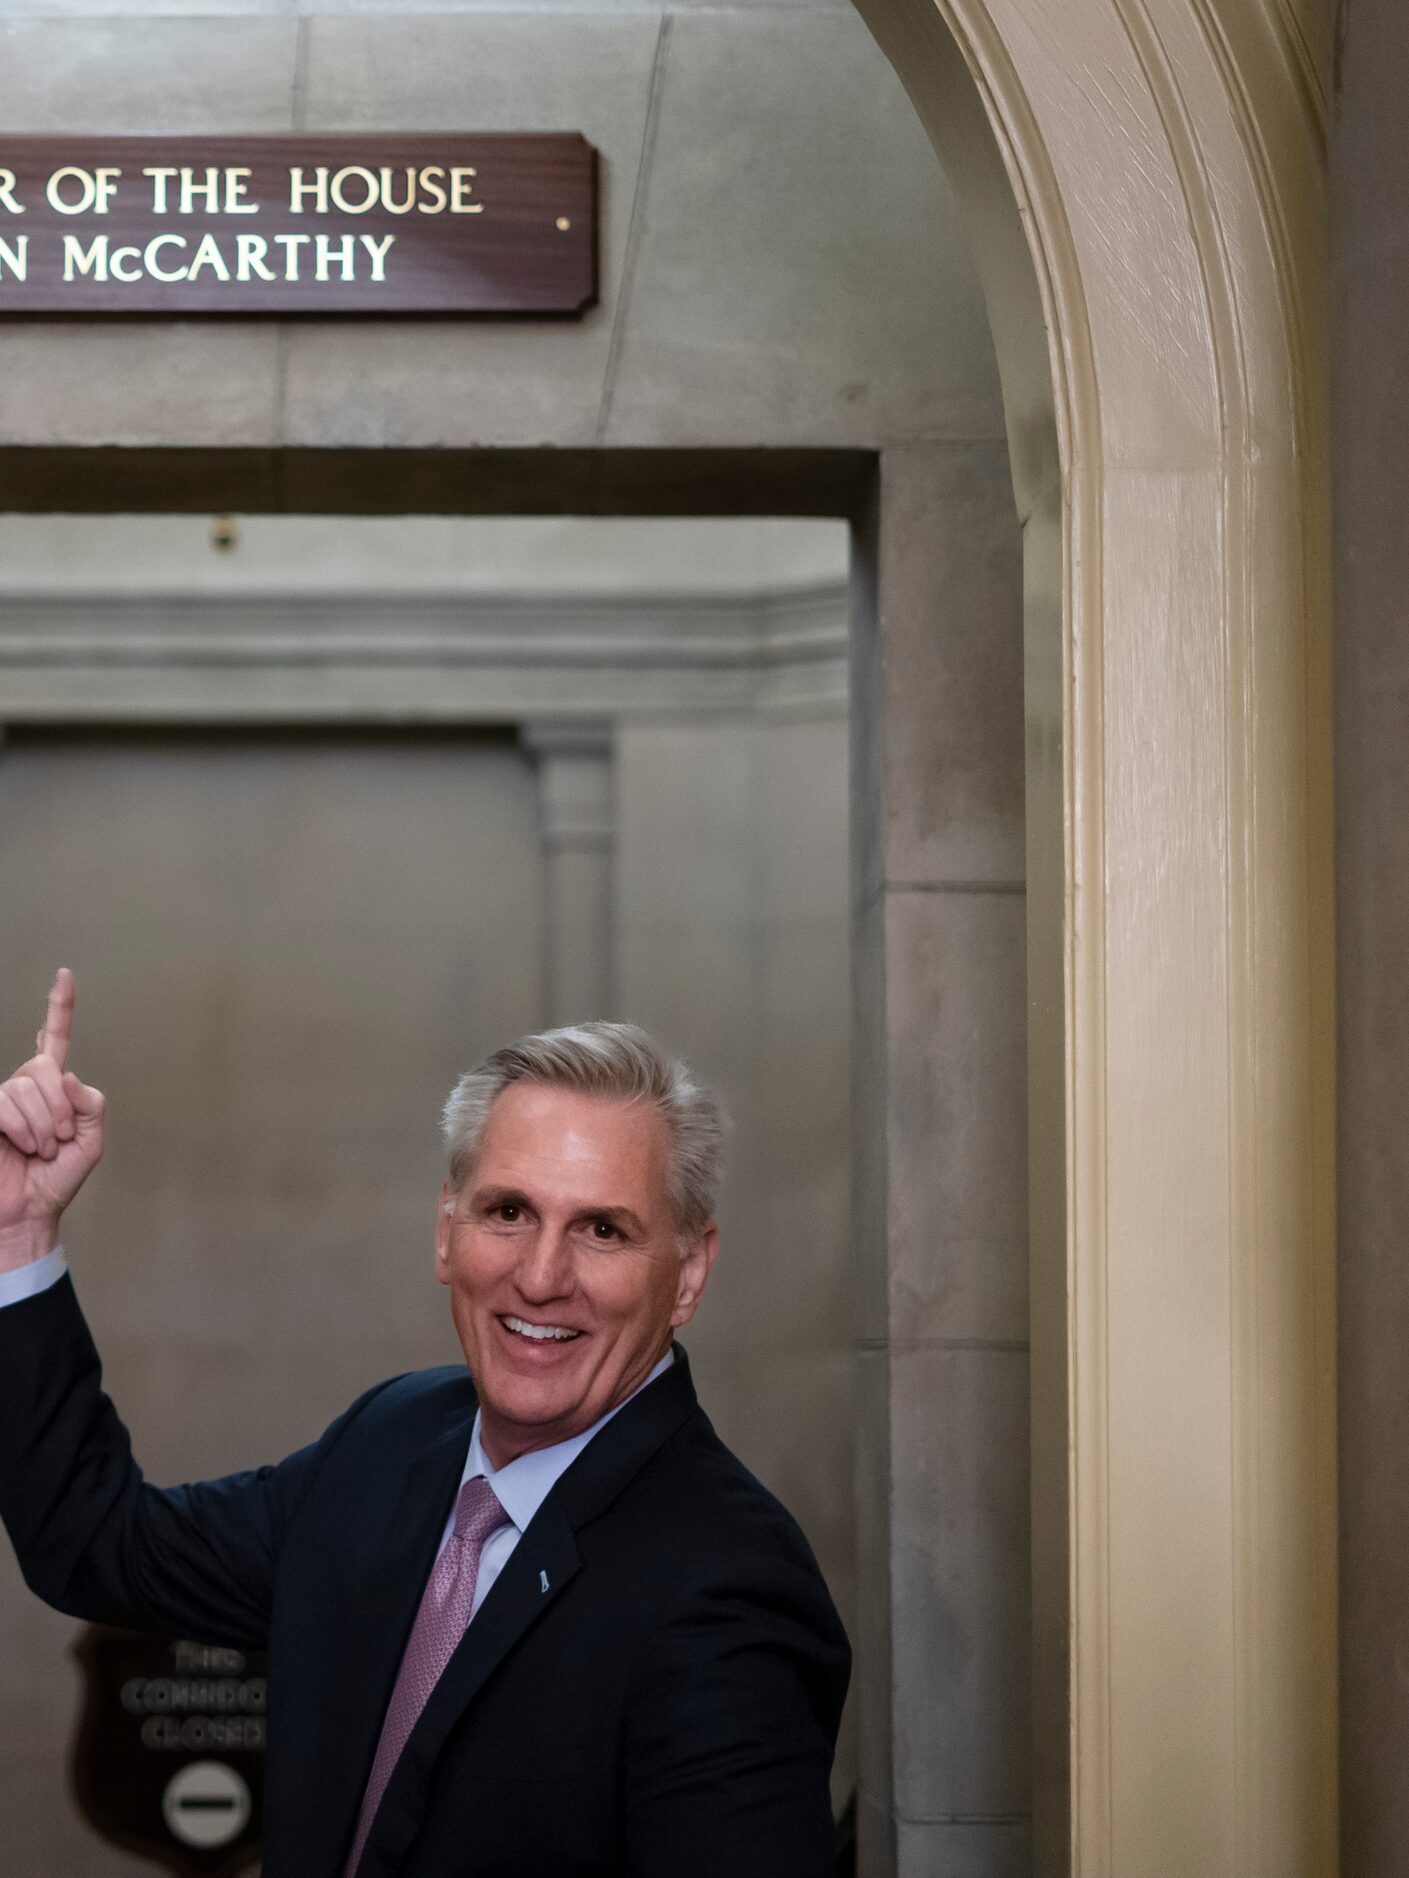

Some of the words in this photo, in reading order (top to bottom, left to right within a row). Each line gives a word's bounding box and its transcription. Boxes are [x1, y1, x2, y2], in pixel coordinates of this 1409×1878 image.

[45, 166, 122, 215] OF
[142, 166, 260, 214] THE
[288, 165, 484, 215] HOUSE
[62, 233, 395, 283] McCARTHY
[121, 1678, 267, 1712] CORRIDO
